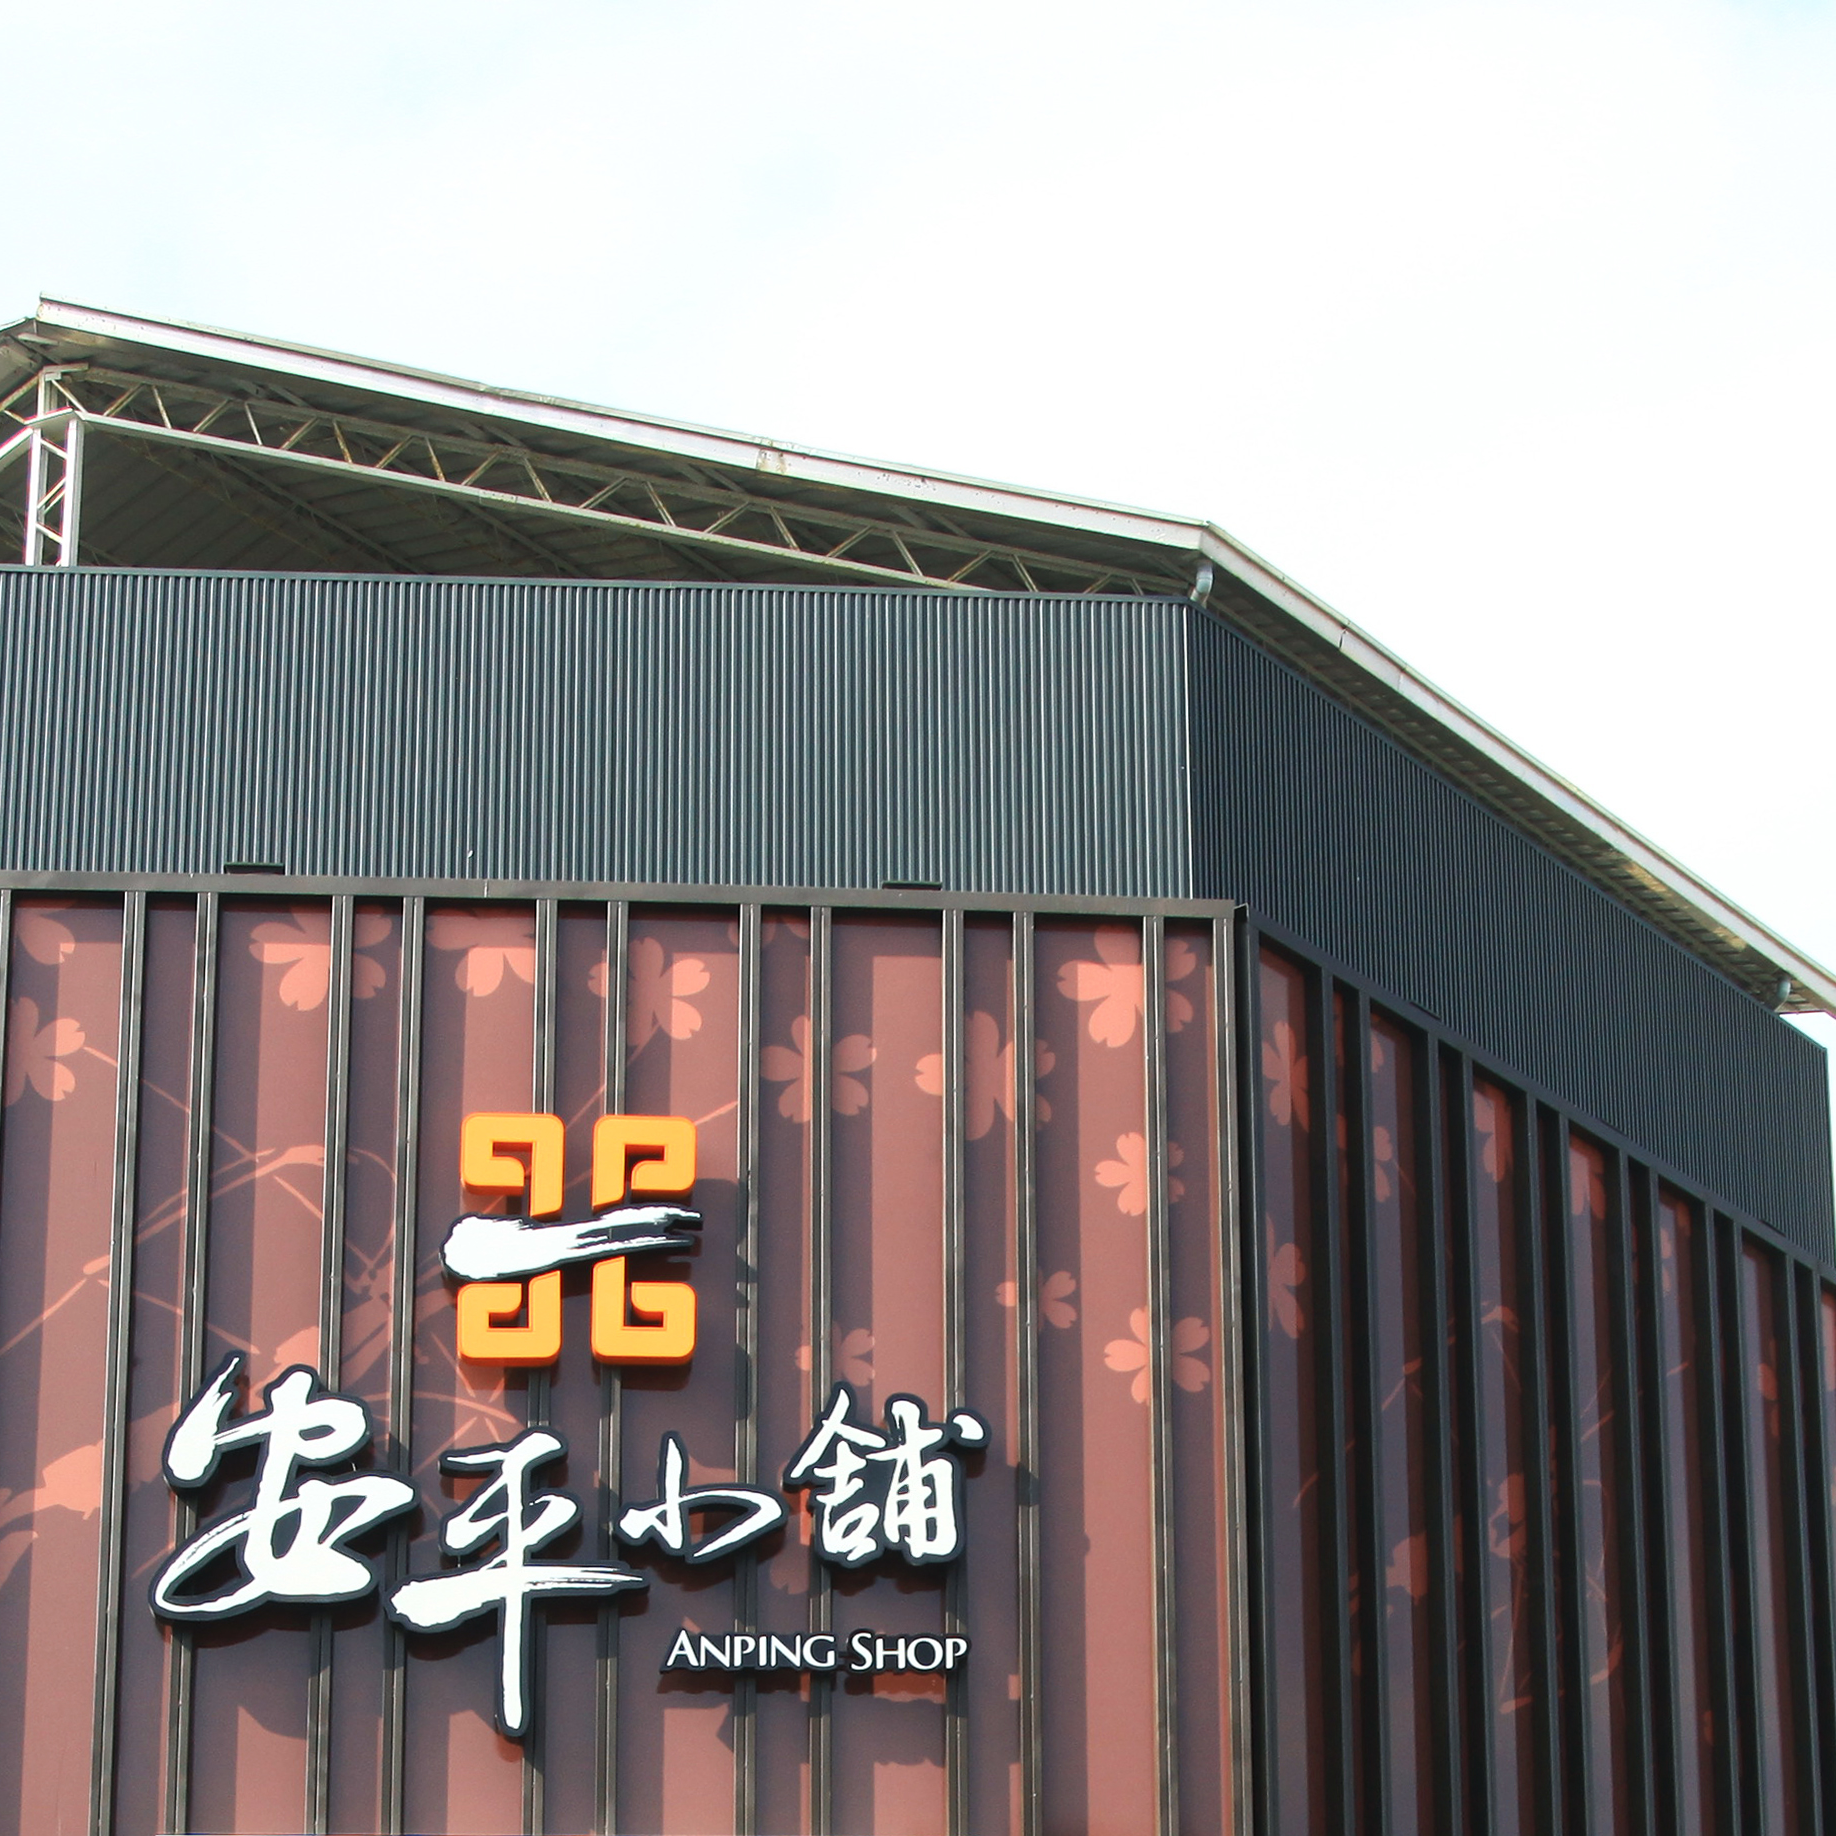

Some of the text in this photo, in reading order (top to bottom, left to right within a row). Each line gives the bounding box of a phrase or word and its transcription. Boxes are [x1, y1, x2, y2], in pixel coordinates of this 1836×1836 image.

[152, 1354, 987, 1733] 安平小舖
[665, 1632, 968, 1671] ANPING SHOP
